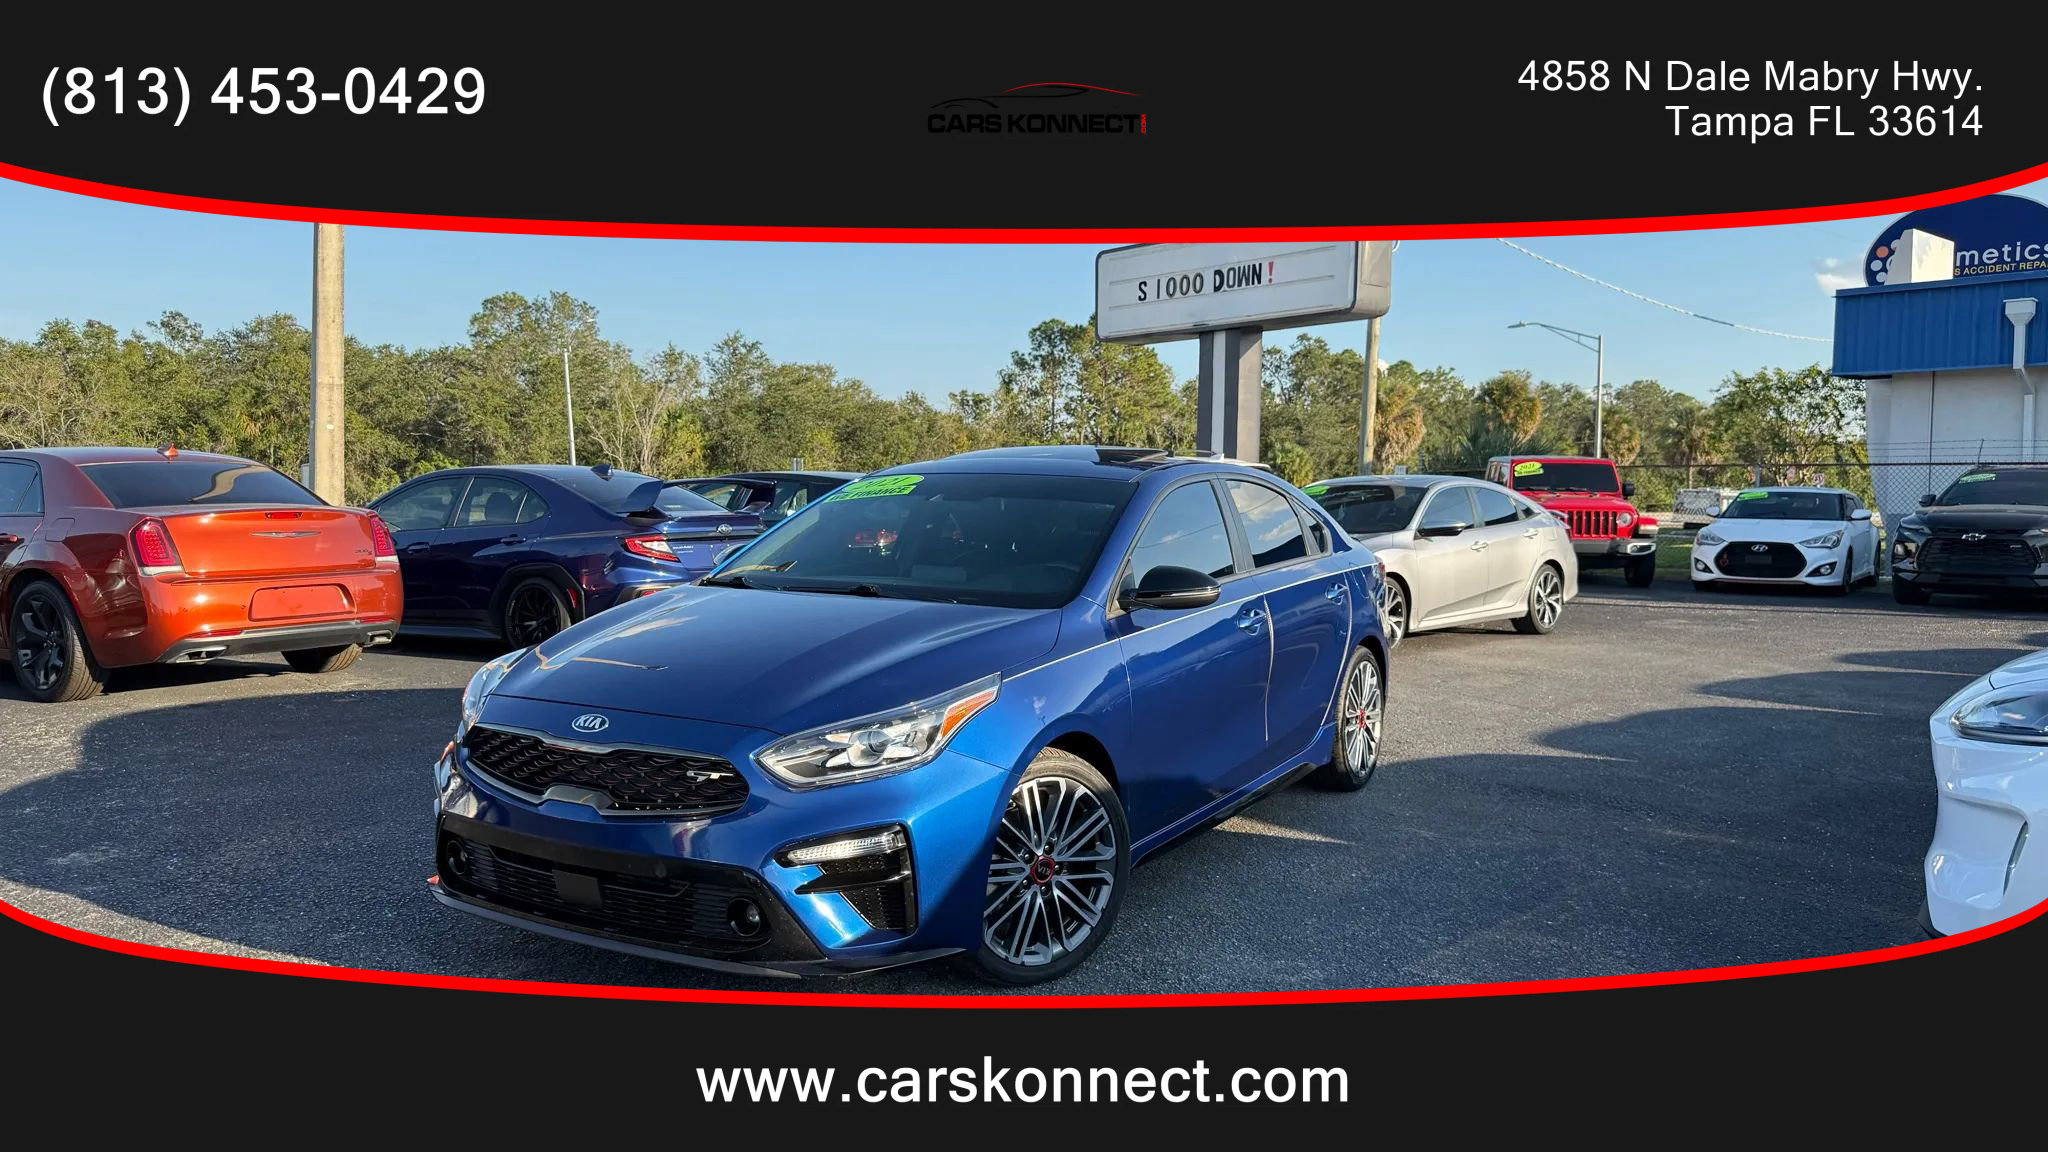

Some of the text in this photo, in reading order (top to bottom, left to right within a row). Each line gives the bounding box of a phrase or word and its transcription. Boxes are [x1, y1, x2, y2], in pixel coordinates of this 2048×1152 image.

[1963, 263, 2017, 276] ACCIDENT
[2019, 260, 2048, 271] REPA
[575, 714, 603, 730] KIA
